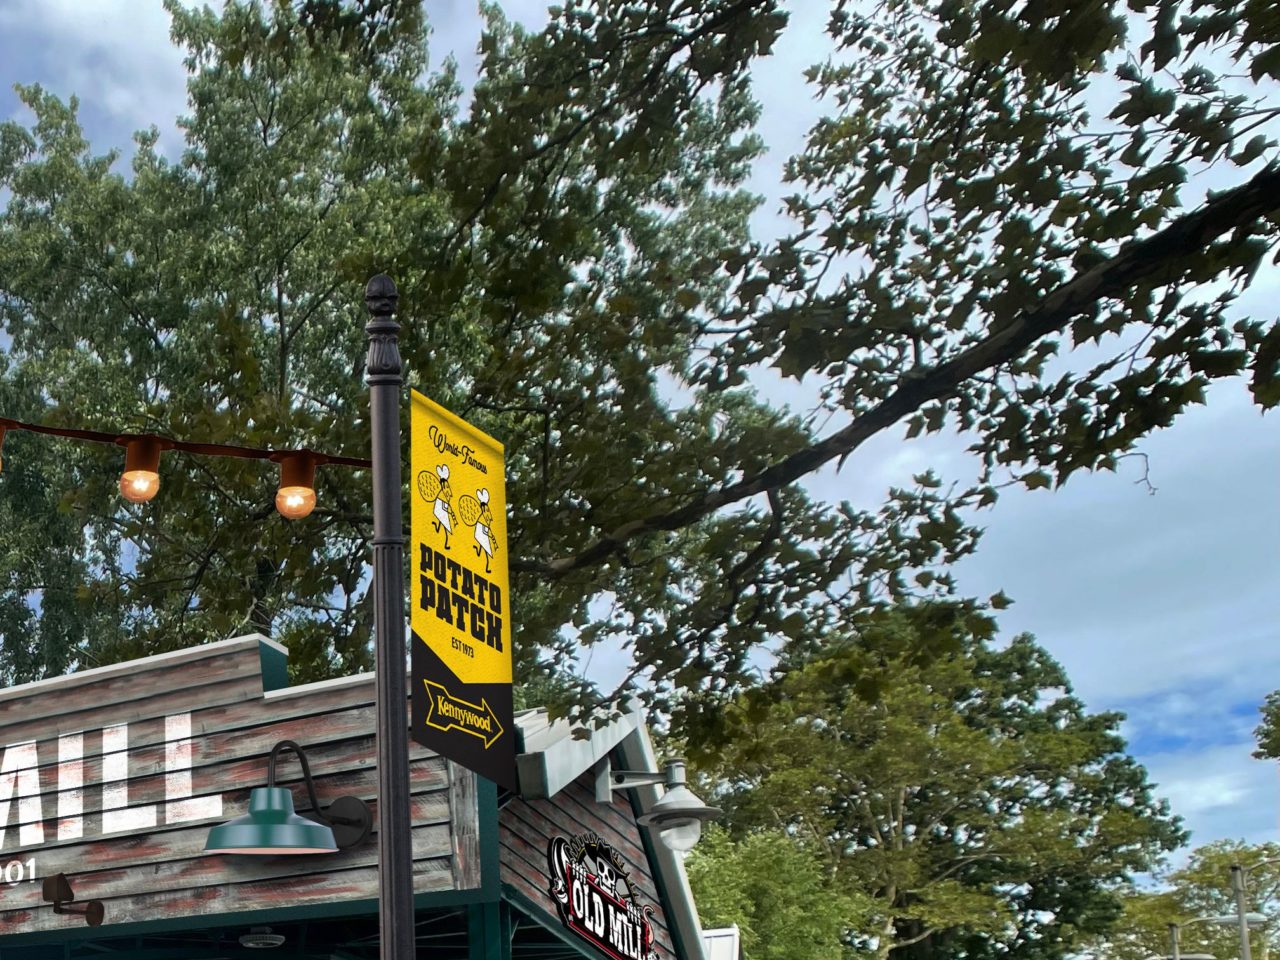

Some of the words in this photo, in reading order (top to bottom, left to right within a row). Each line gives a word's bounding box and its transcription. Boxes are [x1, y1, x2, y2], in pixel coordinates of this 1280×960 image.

[419, 542, 502, 616] POTATO
[419, 573, 503, 654] PATCH
[451, 636, 462, 651] EST
[436, 694, 492, 733] Kennywood
[572, 878, 606, 939] OLD
